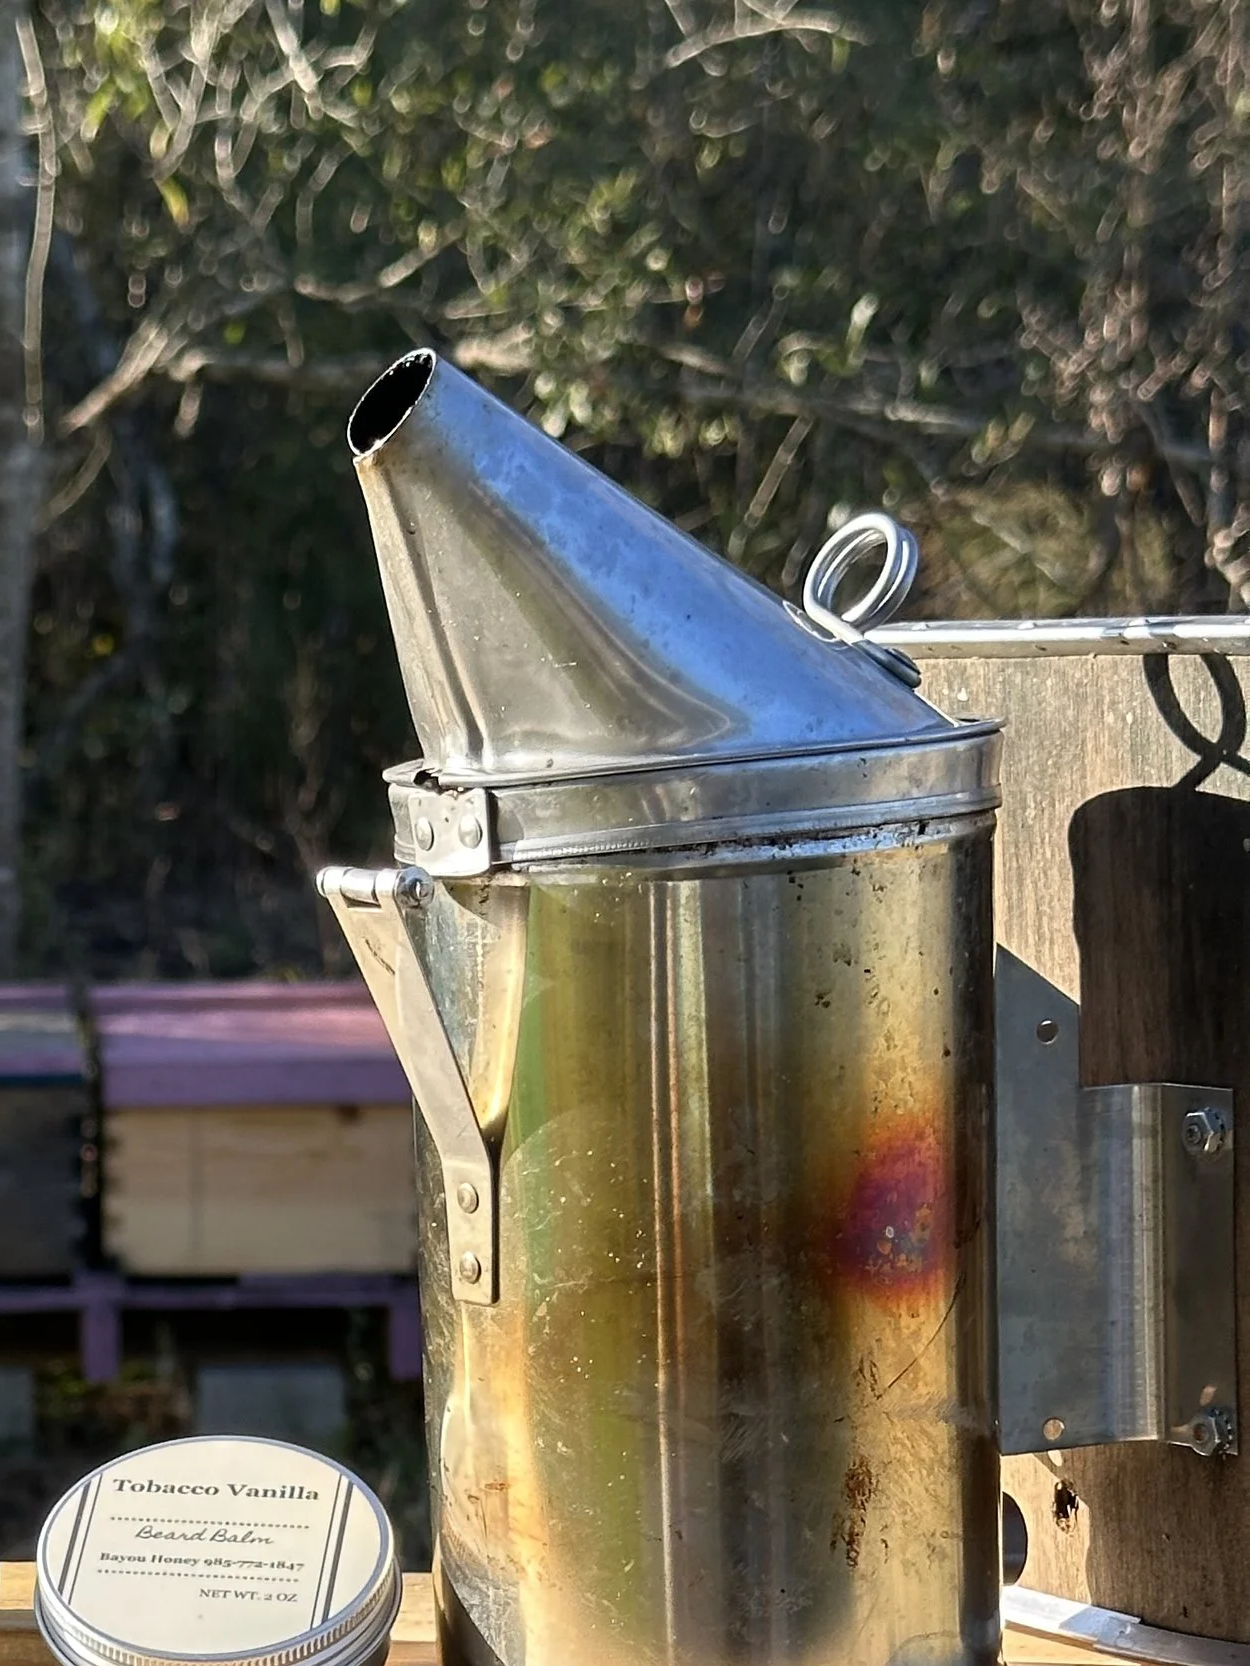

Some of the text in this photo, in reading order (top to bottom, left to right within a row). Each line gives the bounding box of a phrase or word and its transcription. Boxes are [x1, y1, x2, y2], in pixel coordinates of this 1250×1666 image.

[112, 1478, 320, 1501] Tobacco Vanilla
[135, 1525, 274, 1545] Beard Balm
[100, 1551, 305, 1571] Bayou Honey 985-772-1847
[199, 1588, 230, 1600] NET
[263, 1593, 273, 1601] 2
[276, 1591, 299, 1603] OZ
